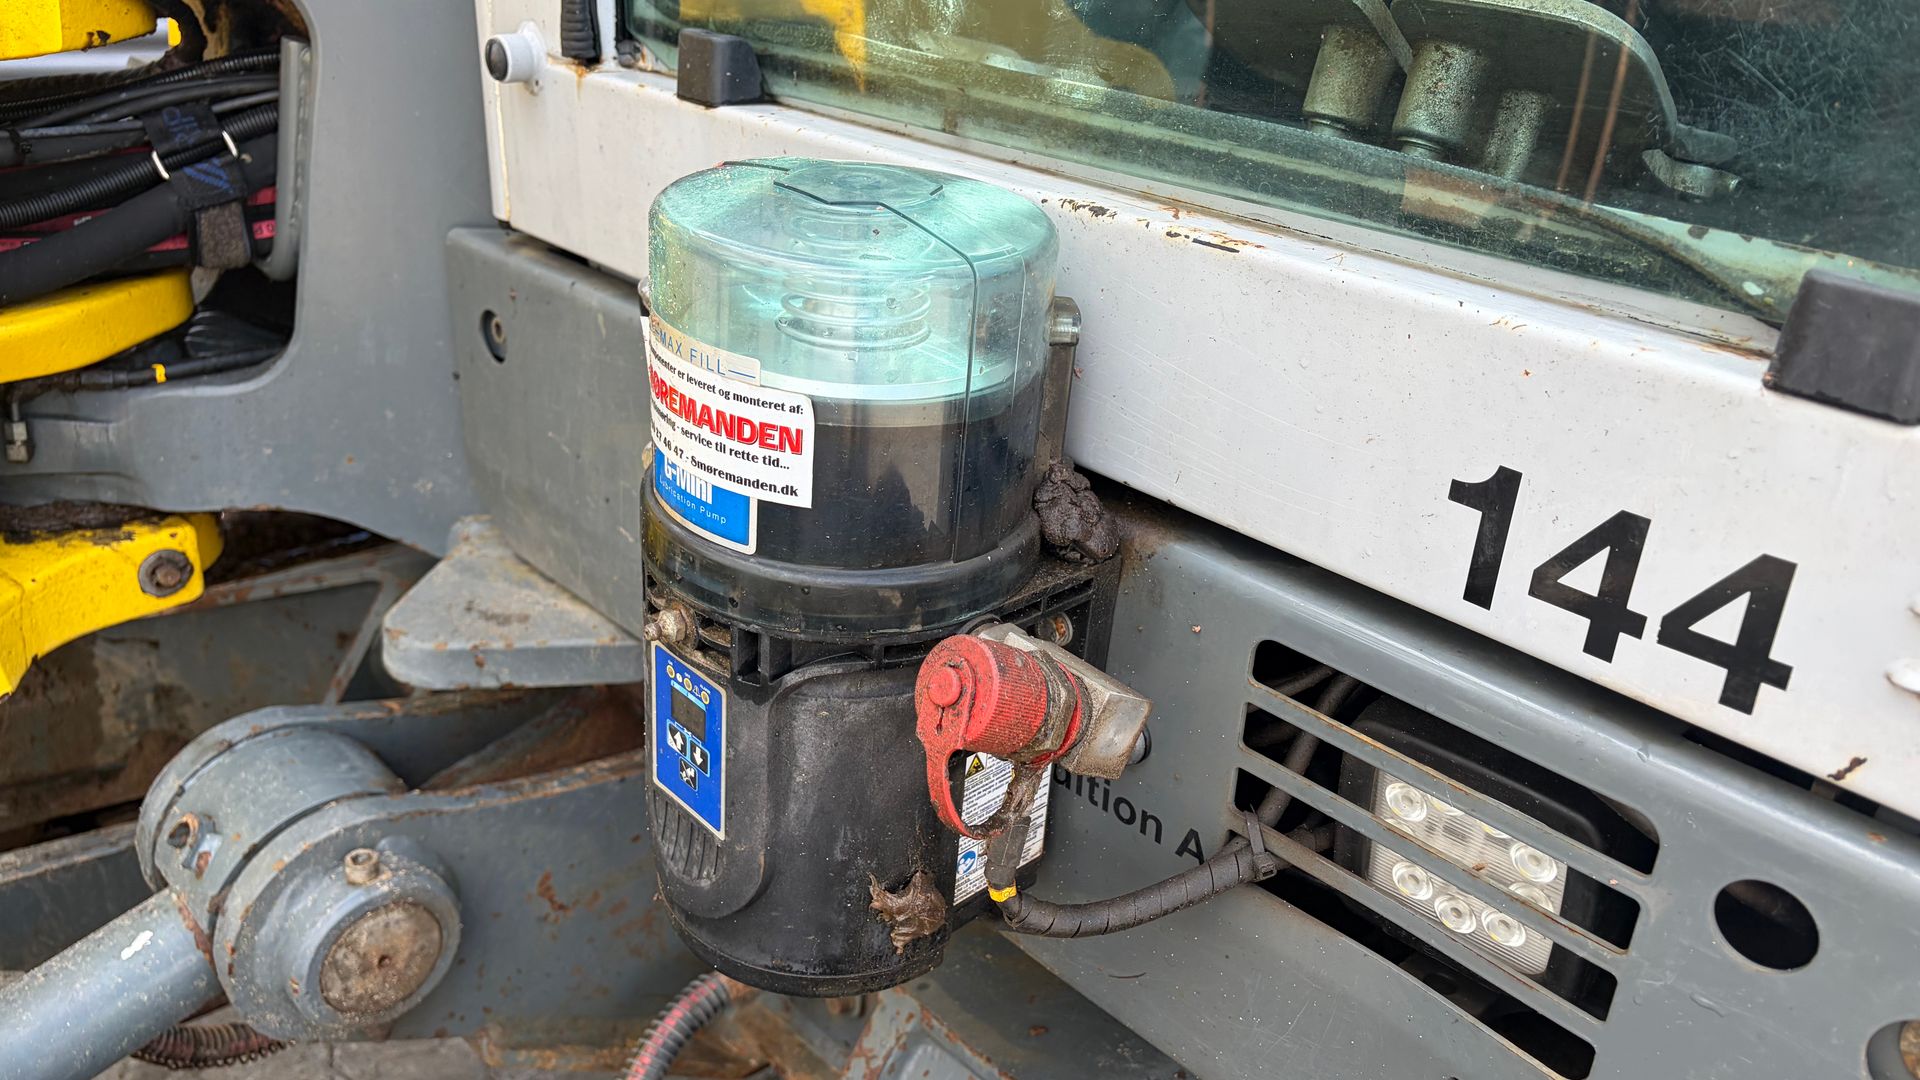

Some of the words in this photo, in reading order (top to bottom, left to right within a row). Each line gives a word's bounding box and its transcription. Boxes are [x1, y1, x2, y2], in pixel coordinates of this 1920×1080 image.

[660, 330, 682, 357] MAX
[690, 348, 726, 376] FILL
[677, 370, 686, 380] er
[686, 373, 717, 394] leveret
[718, 388, 731, 401] og
[733, 392, 786, 411] monteret
[789, 404, 804, 415] af:
[673, 445, 684, 459] 47
[690, 455, 799, 497] Smøremanden.dk
[680, 425, 713, 449] service
[715, 438, 726, 453] til
[729, 447, 759, 464] rette
[762, 454, 790, 470] tid...
[660, 474, 696, 510] Lubrication
[699, 505, 727, 525] Pump
[1448, 465, 1798, 715] 144
